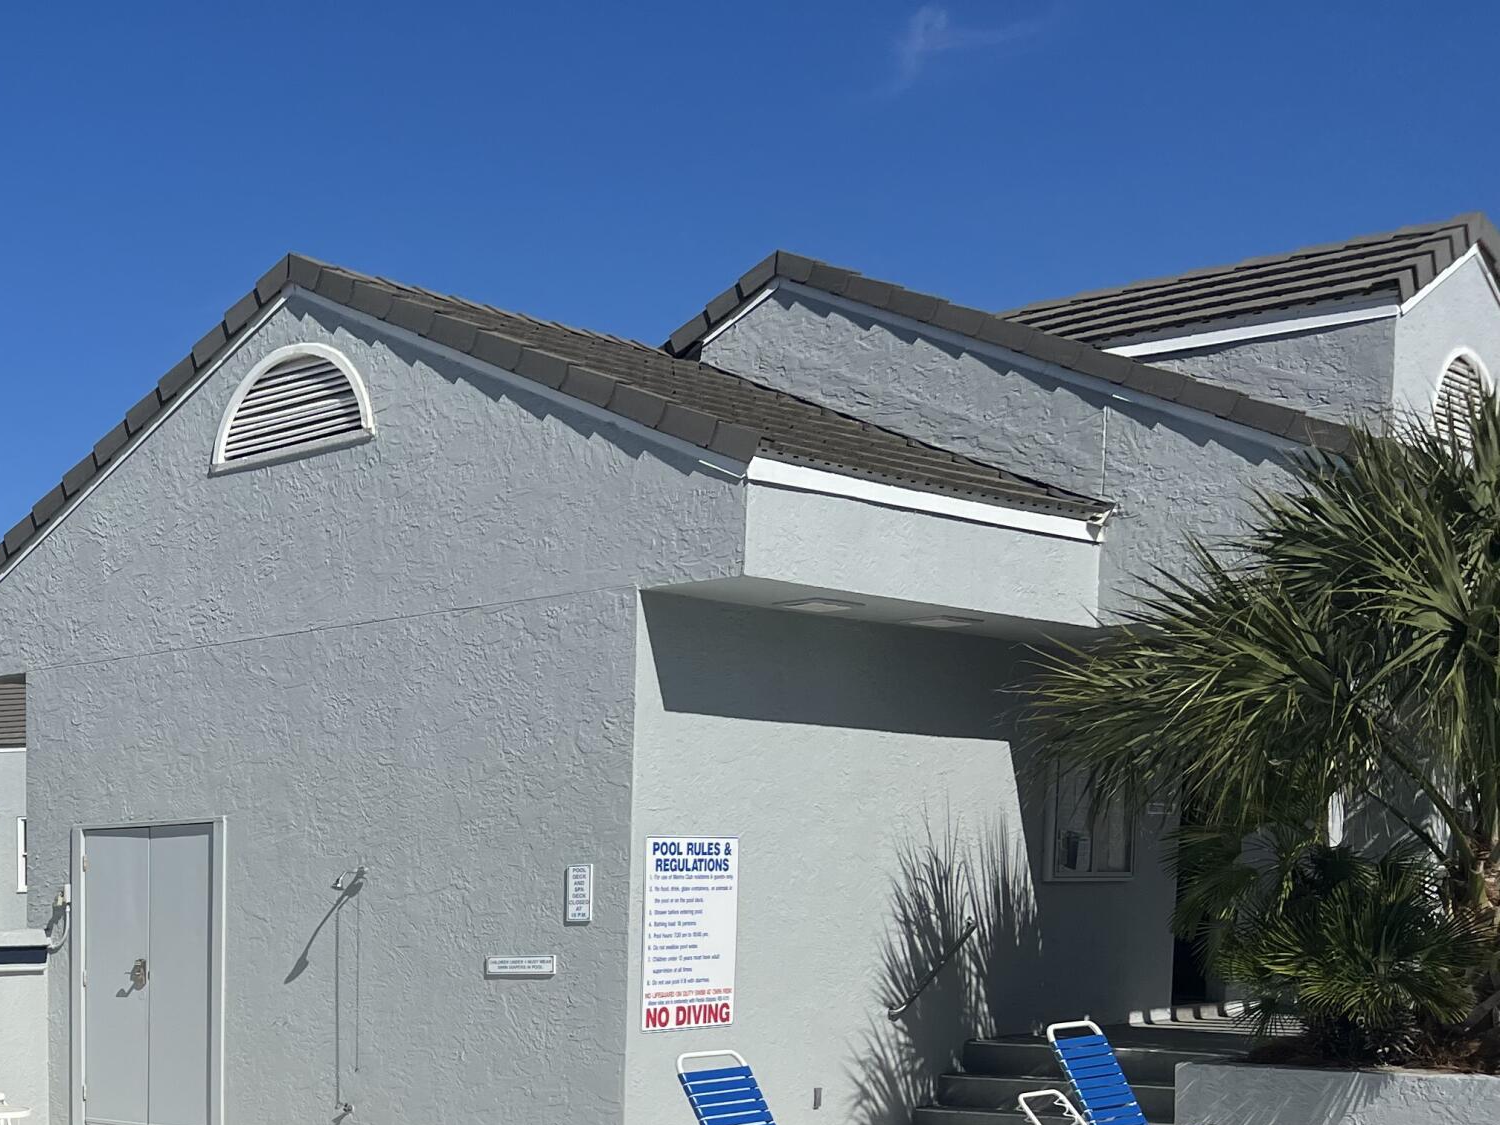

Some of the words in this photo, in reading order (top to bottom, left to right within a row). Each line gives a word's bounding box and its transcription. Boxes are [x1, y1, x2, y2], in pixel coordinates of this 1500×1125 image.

[652, 842, 683, 856] POOL
[686, 842, 721, 856] RULES
[724, 842, 732, 856] &
[655, 858, 729, 872] REGULATIONS
[646, 1007, 670, 1028] NO
[675, 1002, 730, 1026] DIVING
